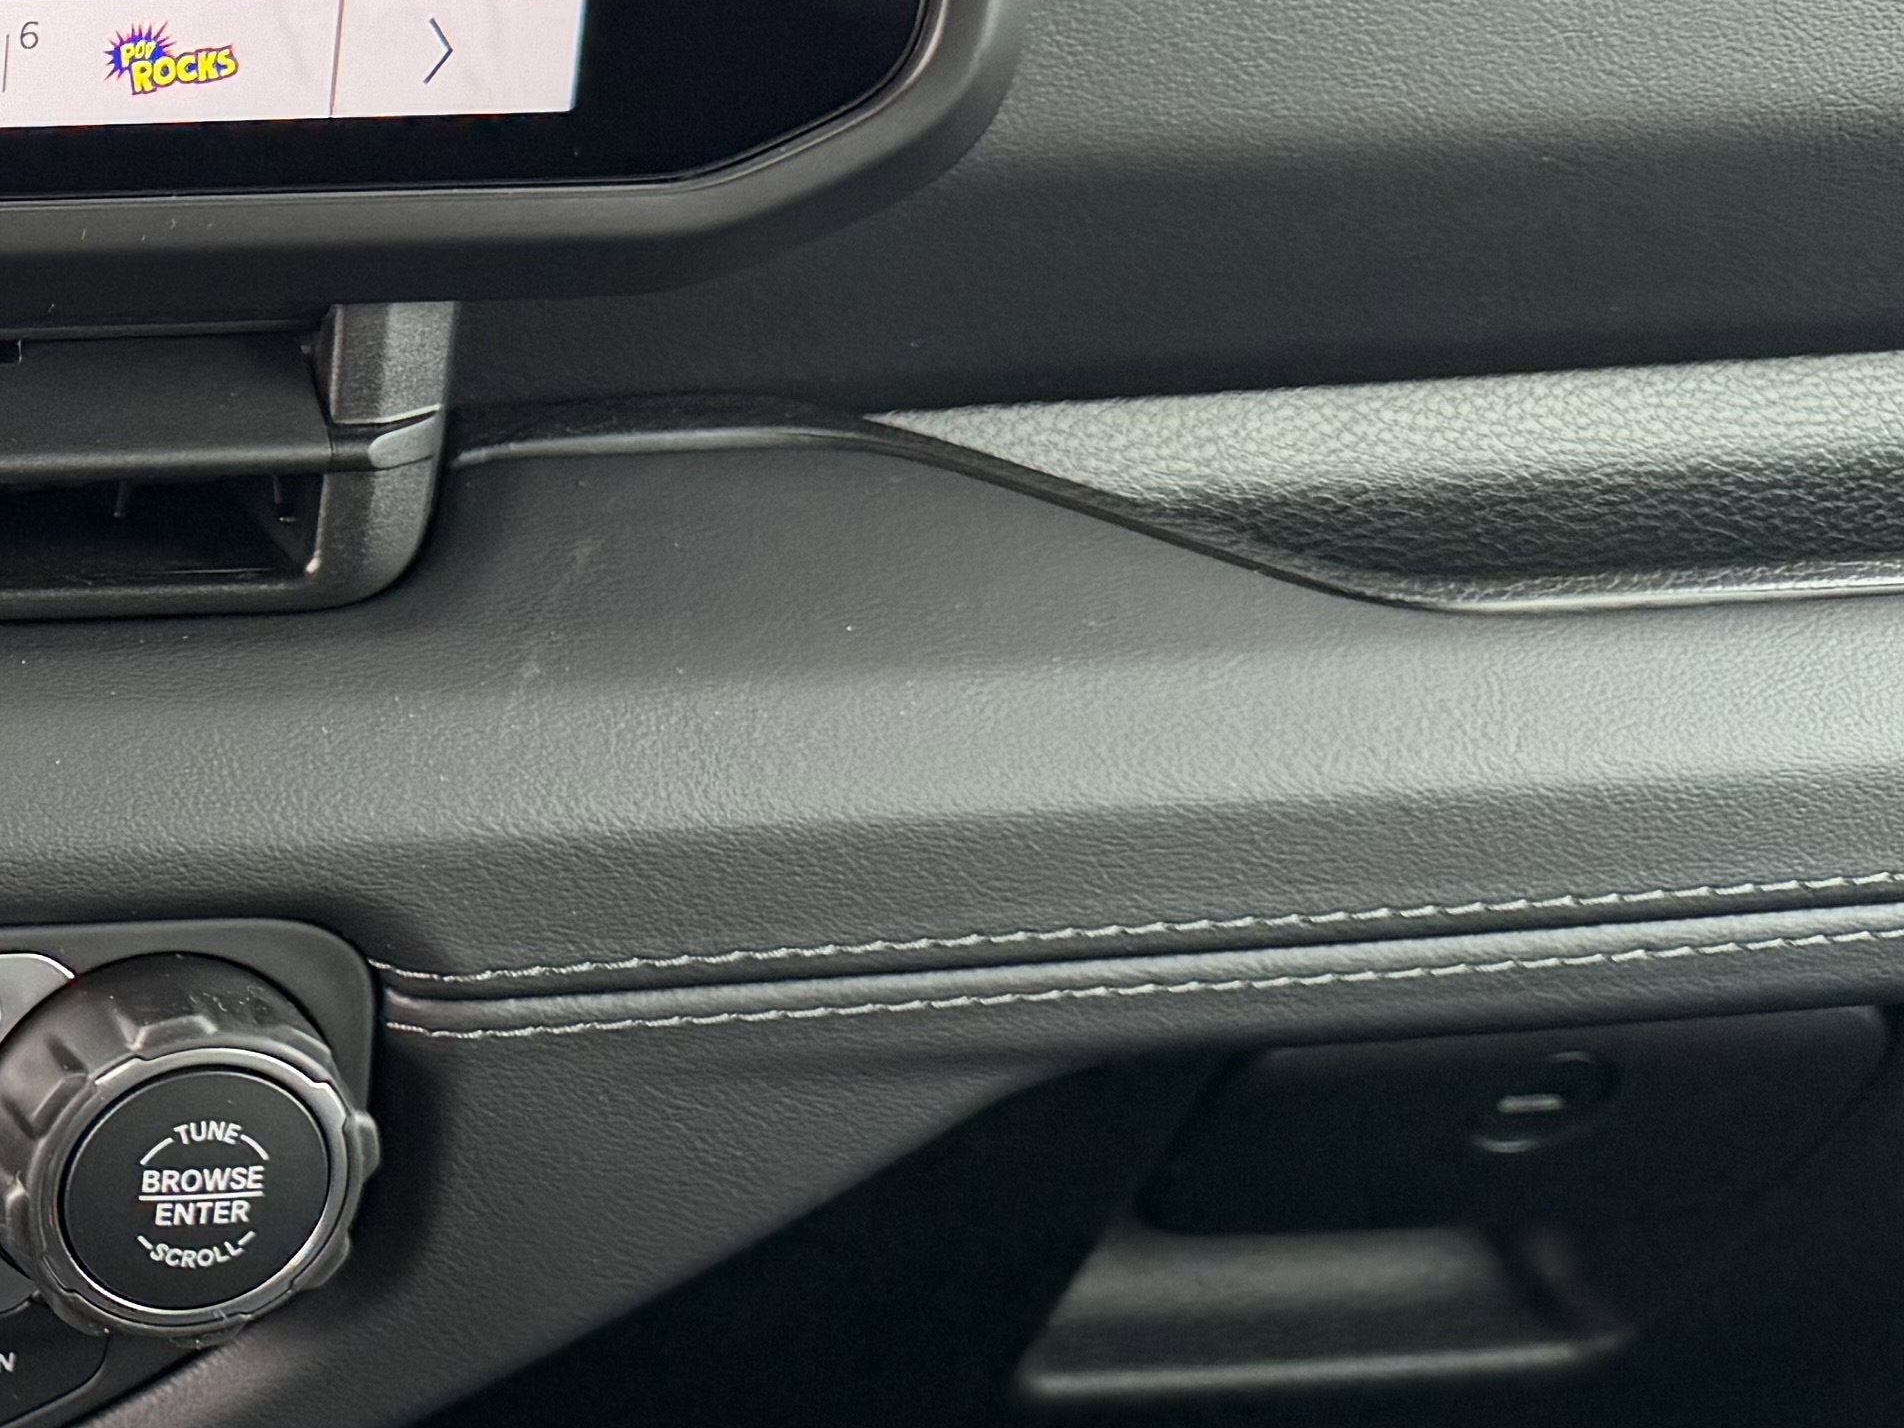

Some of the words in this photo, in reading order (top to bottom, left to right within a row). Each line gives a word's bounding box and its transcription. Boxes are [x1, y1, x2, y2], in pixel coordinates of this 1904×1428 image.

[18, 21, 39, 51] 6
[120, 39, 156, 68] POP
[131, 47, 238, 94] ROCKS
[173, 1120, 241, 1147] TUNE
[140, 1165, 264, 1195] BROWSE
[153, 1198, 250, 1228] ENTER
[147, 1238, 244, 1268] SCROLL
